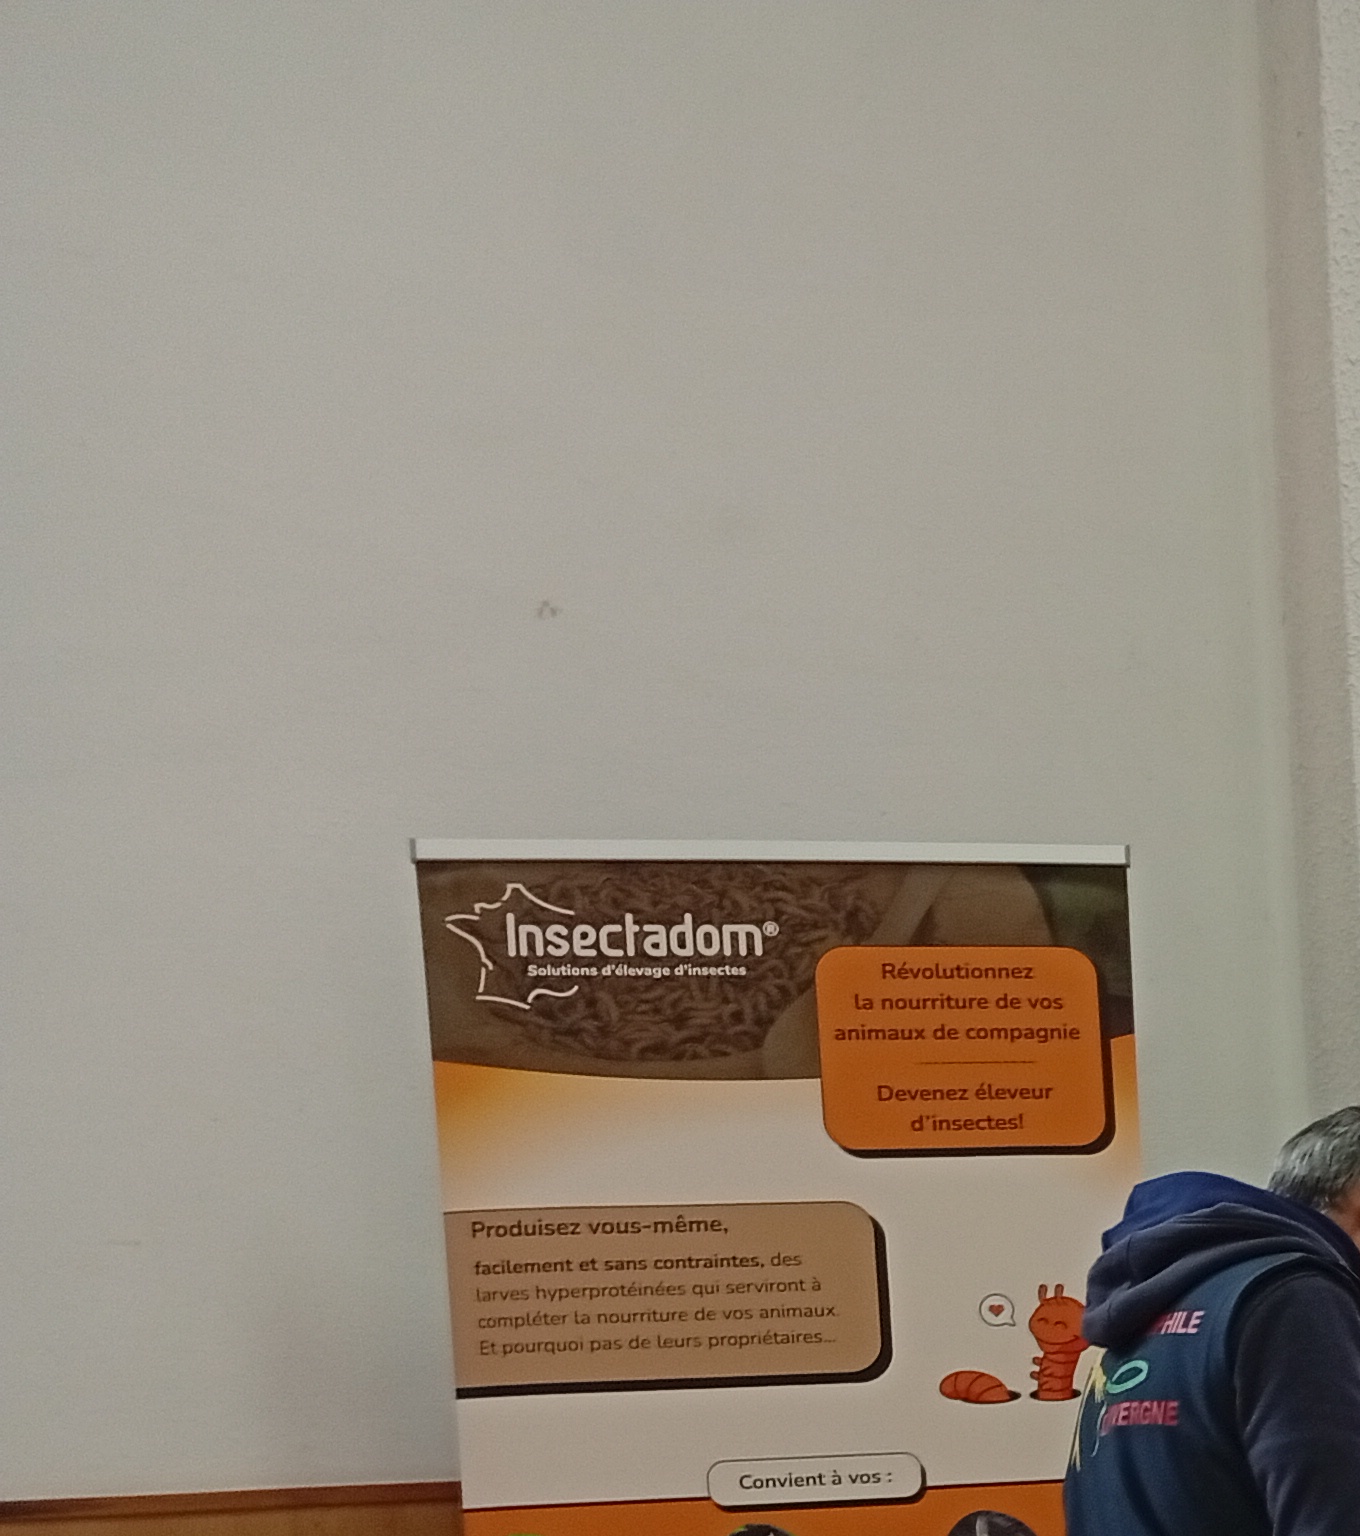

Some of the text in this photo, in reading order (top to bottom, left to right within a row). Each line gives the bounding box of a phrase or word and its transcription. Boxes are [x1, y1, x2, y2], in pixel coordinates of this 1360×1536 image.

[527, 964, 599, 977] Solutions
[674, 963, 748, 977] d'insectes
[881, 961, 1034, 981] Révolutionnez
[854, 992, 1065, 1011] la nourriture de vos
[834, 1021, 1082, 1044] animaux de compagnie
[877, 1081, 1054, 1103] Devenez éleveur
[910, 1113, 1025, 1133] d'insectes!
[470, 1214, 730, 1239] Produisez vous-même,
[474, 1251, 803, 1277] facilement et sans contraintes, des
[476, 1276, 822, 1304] larves hyperprotéinées qui serviront à
[478, 1309, 568, 1331] compléter
[573, 1310, 591, 1326] la
[597, 1307, 688, 1326] nourriture
[693, 1306, 717, 1323] de
[722, 1308, 754, 1322] vos
[479, 1339, 498, 1356] Et
[502, 1336, 584, 1358] pourquoi
[589, 1335, 623, 1354] pas
[628, 1333, 652, 1350] de
[656, 1332, 702, 1350] leurs
[739, 1472, 827, 1491] Convient
[830, 1469, 843, 1487] à
[847, 1470, 882, 1485] vos
